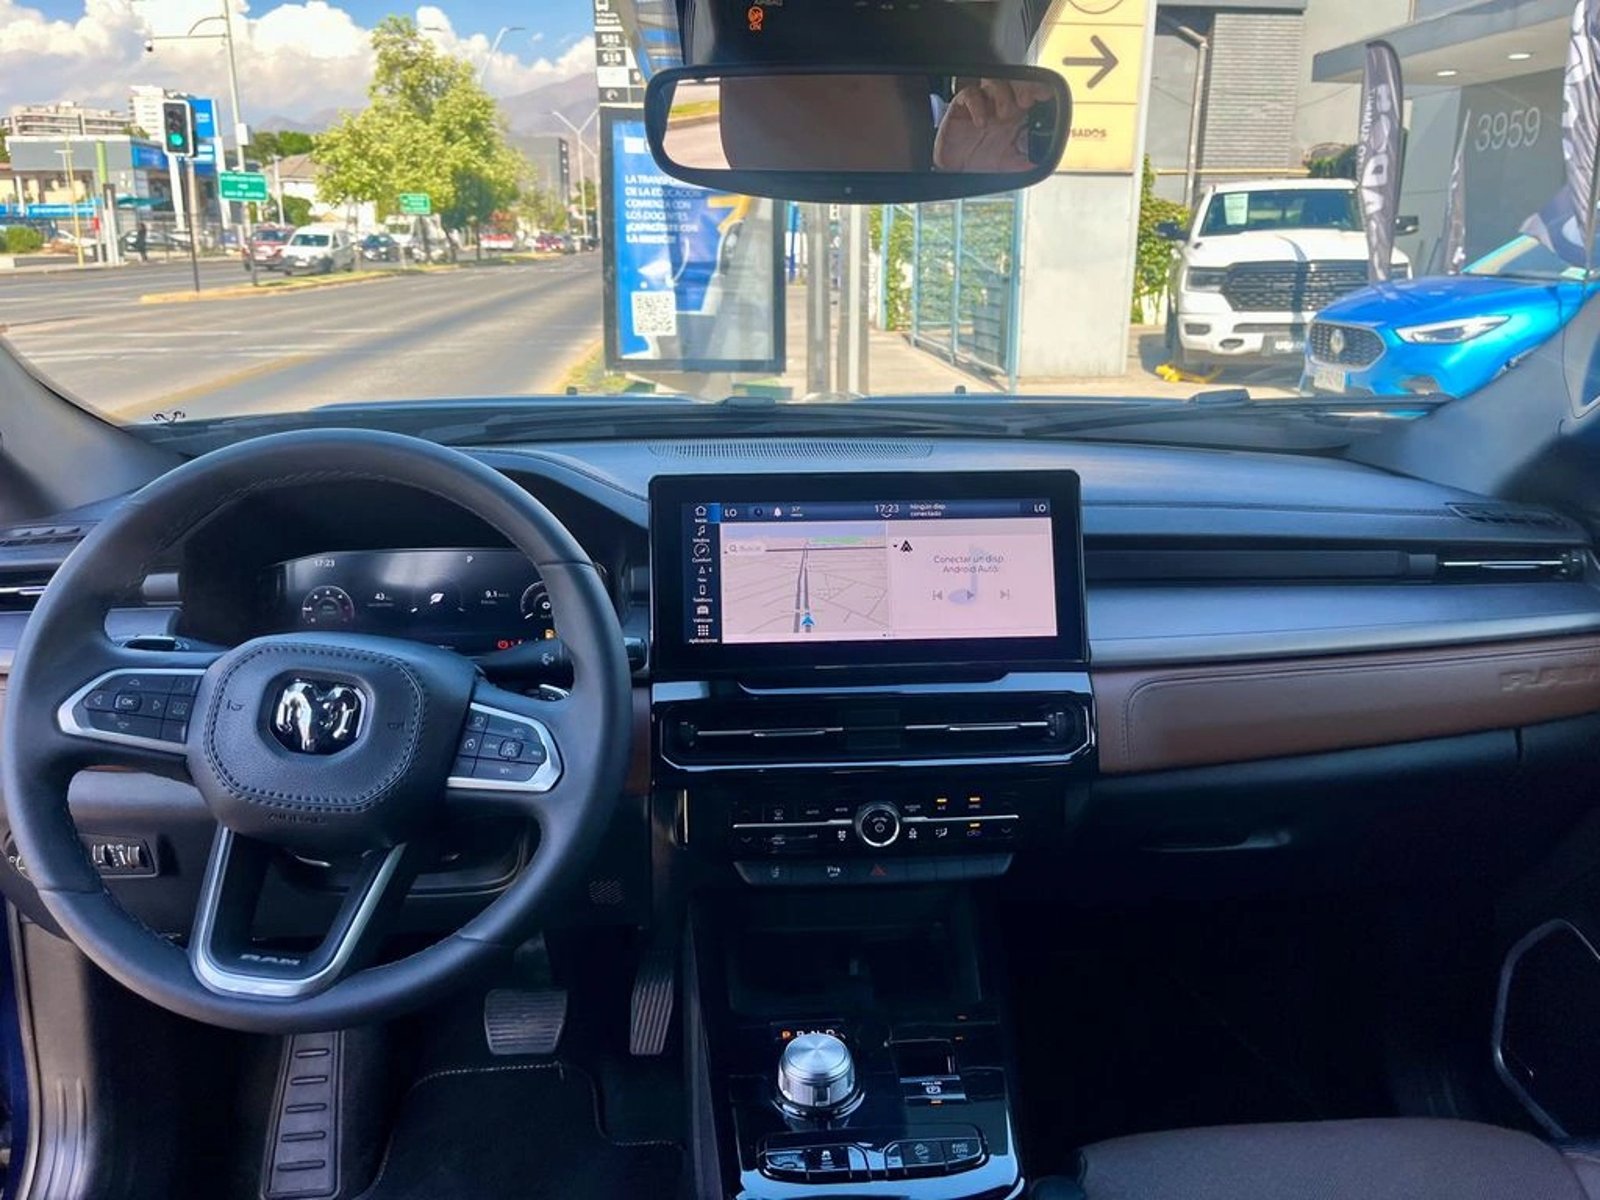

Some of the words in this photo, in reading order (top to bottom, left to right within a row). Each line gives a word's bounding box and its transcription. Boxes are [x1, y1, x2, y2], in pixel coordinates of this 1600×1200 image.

[1070, 128, 1107, 138] SADOS
[1475, 106, 1542, 151] 3959
[624, 174, 637, 185] LA
[624, 186, 638, 197] DE
[639, 187, 652, 197] LA
[673, 200, 692, 210] CON
[625, 211, 642, 221] LOS
[724, 508, 737, 517] LO
[874, 503, 900, 514] 17:23
[1033, 503, 1046, 513] LO
[121, 697, 134, 706] OK
[240, 953, 301, 966] RAM
